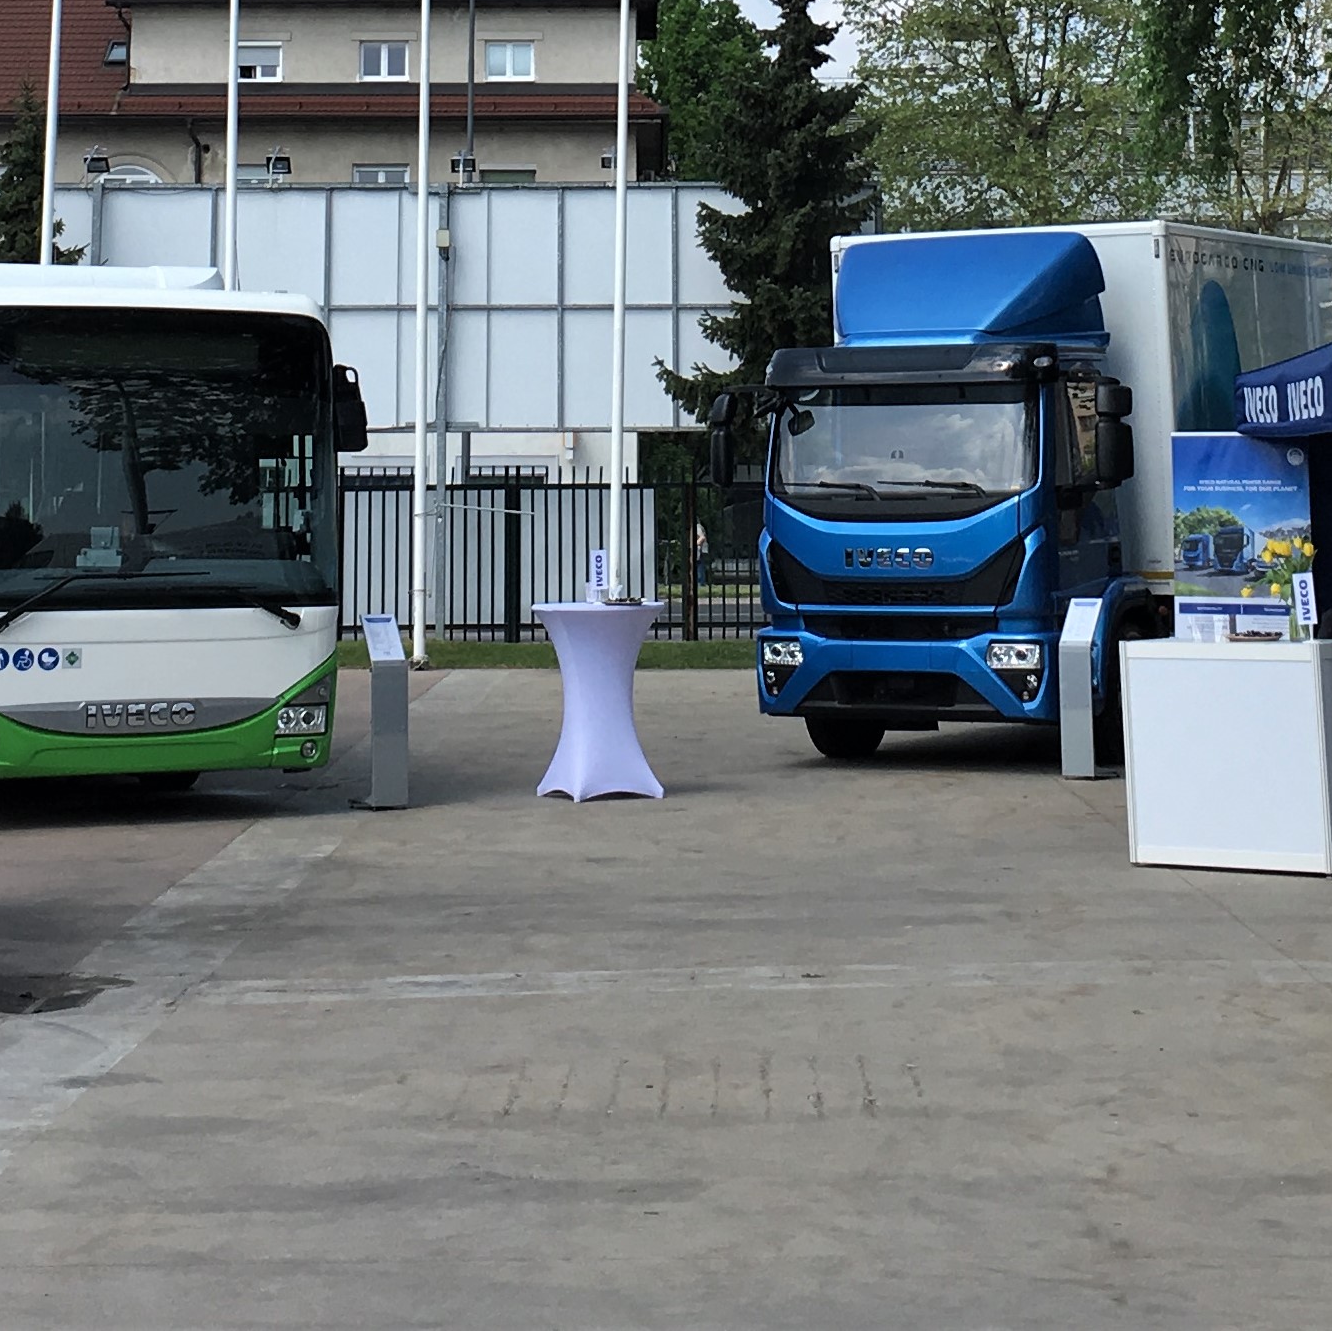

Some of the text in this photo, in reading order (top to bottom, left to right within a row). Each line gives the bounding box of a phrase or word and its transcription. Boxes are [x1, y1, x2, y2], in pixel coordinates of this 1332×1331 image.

[1243, 257, 1264, 272] CNG
[1244, 385, 1278, 423] IVECO
[1287, 375, 1324, 421] IVECO
[595, 555, 603, 587] IVECO
[845, 547, 934, 569] IVECO
[1299, 579, 1311, 621] IVECO
[86, 702, 195, 728] IVECO
